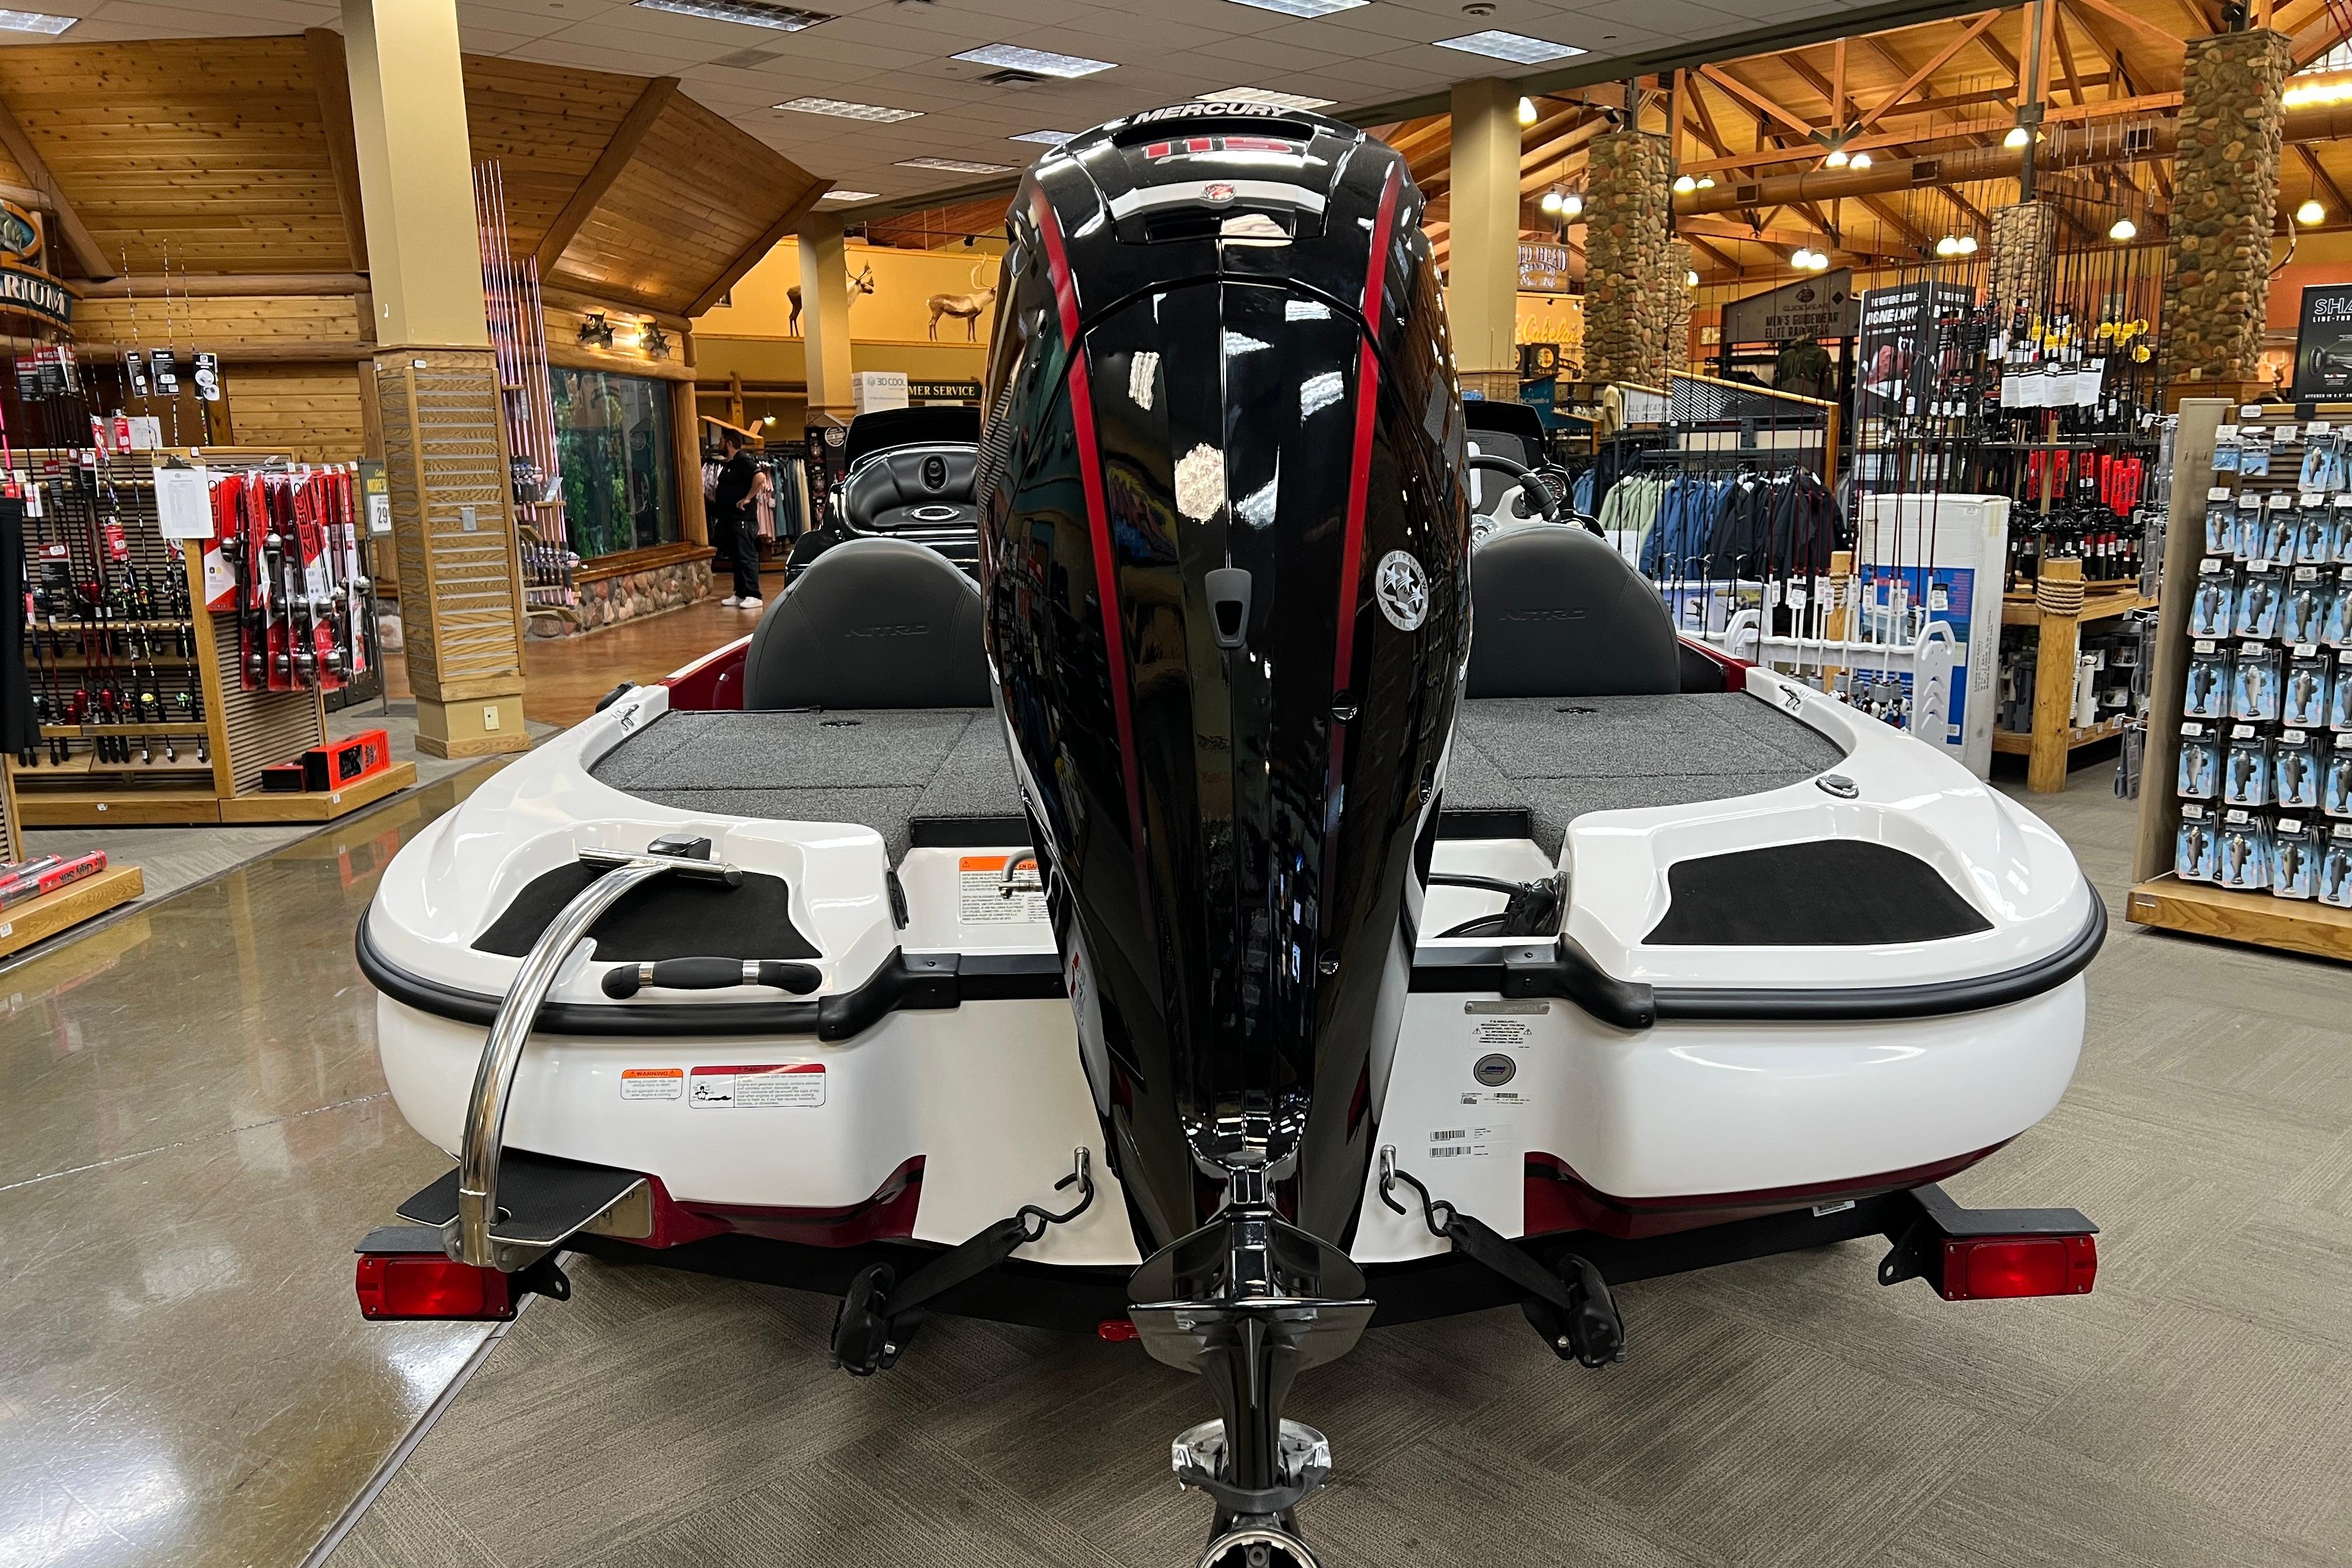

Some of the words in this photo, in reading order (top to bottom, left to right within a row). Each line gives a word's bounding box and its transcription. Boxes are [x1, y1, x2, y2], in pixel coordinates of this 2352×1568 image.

[1132, 103, 1286, 125] MERCURY
[1142, 136, 1293, 159] 115
[1536, 247, 1566, 271] HEAD
[1766, 315, 1790, 327] MEN'S
[1793, 312, 1838, 325] GUIDEWEAR
[908, 386, 931, 396] MER
[933, 386, 975, 396] SERVICE
[293, 482, 313, 555] ZEBCO
[1388, 553, 1412, 564] ULTRA
[1416, 566, 1427, 589] LOW
[1499, 608, 1588, 621] NITRO
[845, 624, 929, 637] NITRO
